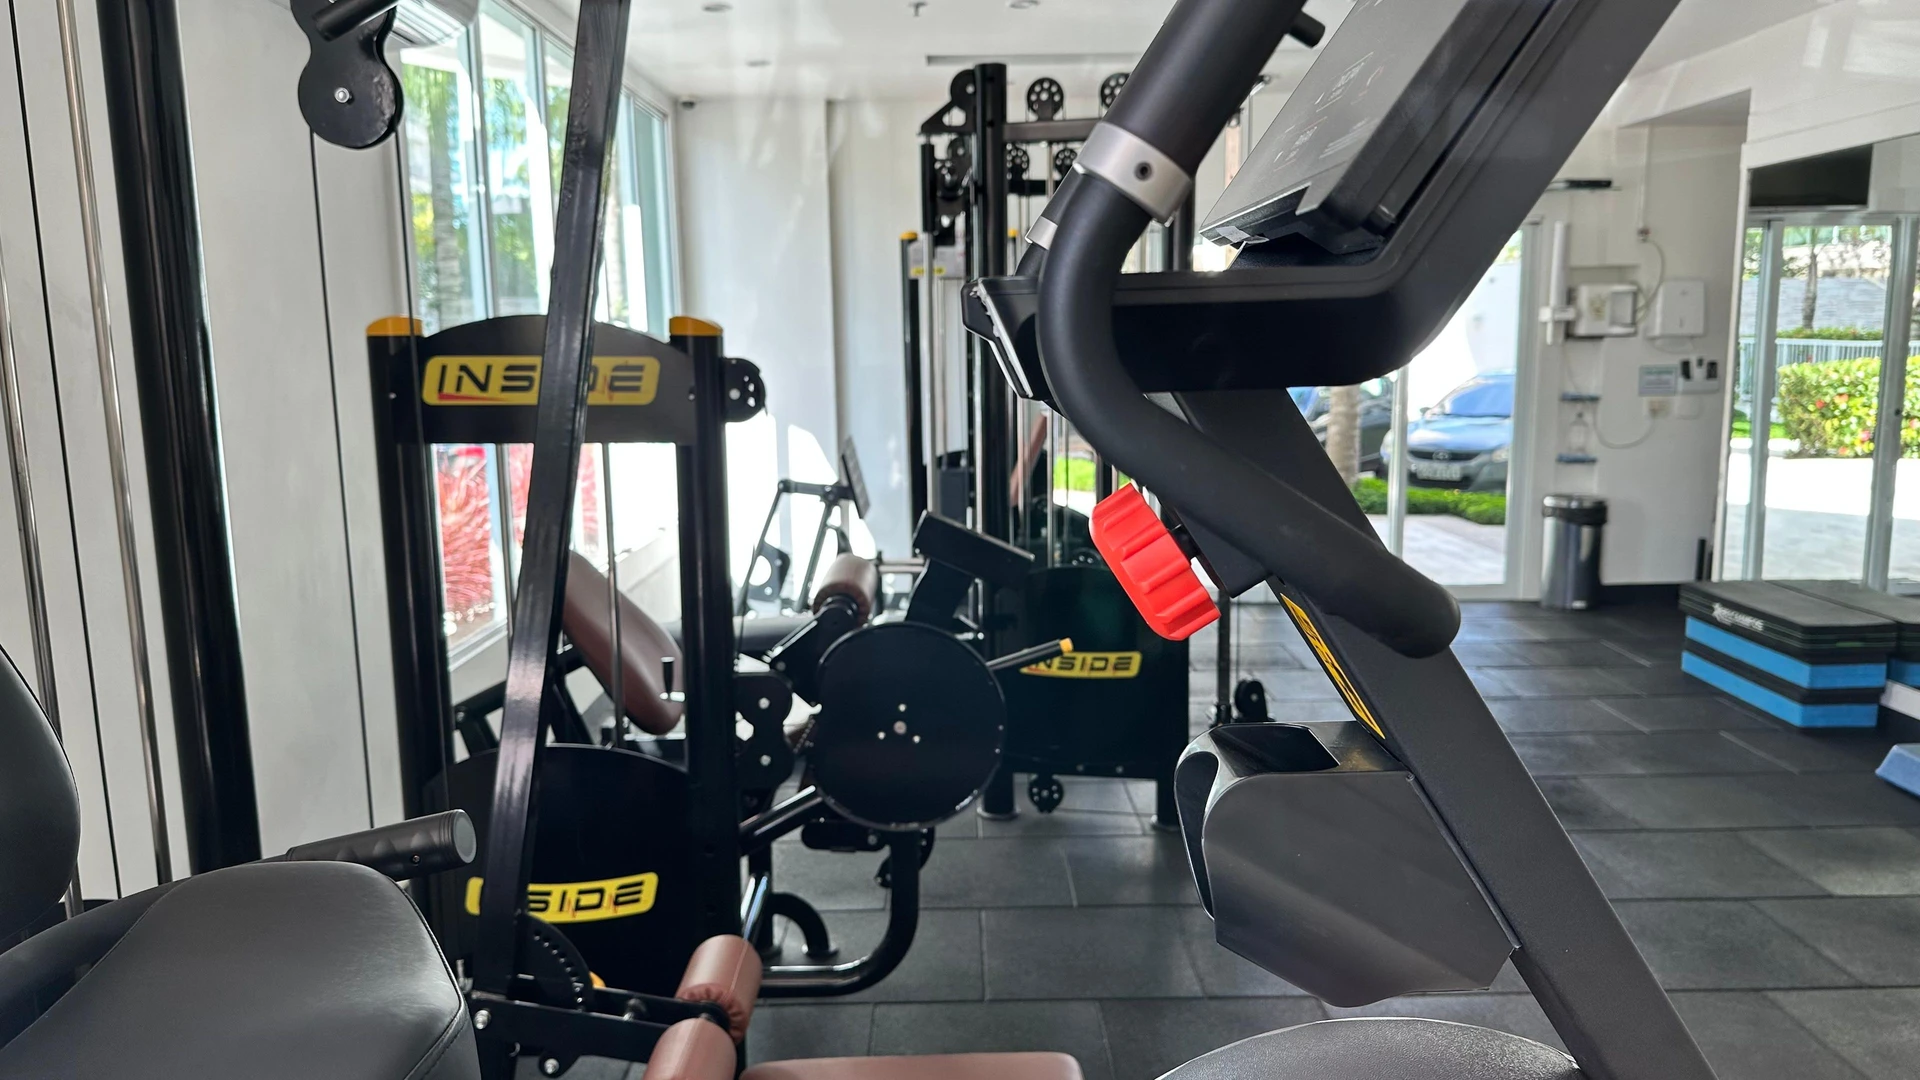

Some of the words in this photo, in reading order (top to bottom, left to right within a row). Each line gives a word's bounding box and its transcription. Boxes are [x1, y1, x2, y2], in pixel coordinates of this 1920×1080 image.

[438, 364, 645, 393] INSE
[1035, 656, 1132, 671] NSIDE
[528, 880, 644, 912] SIDE
